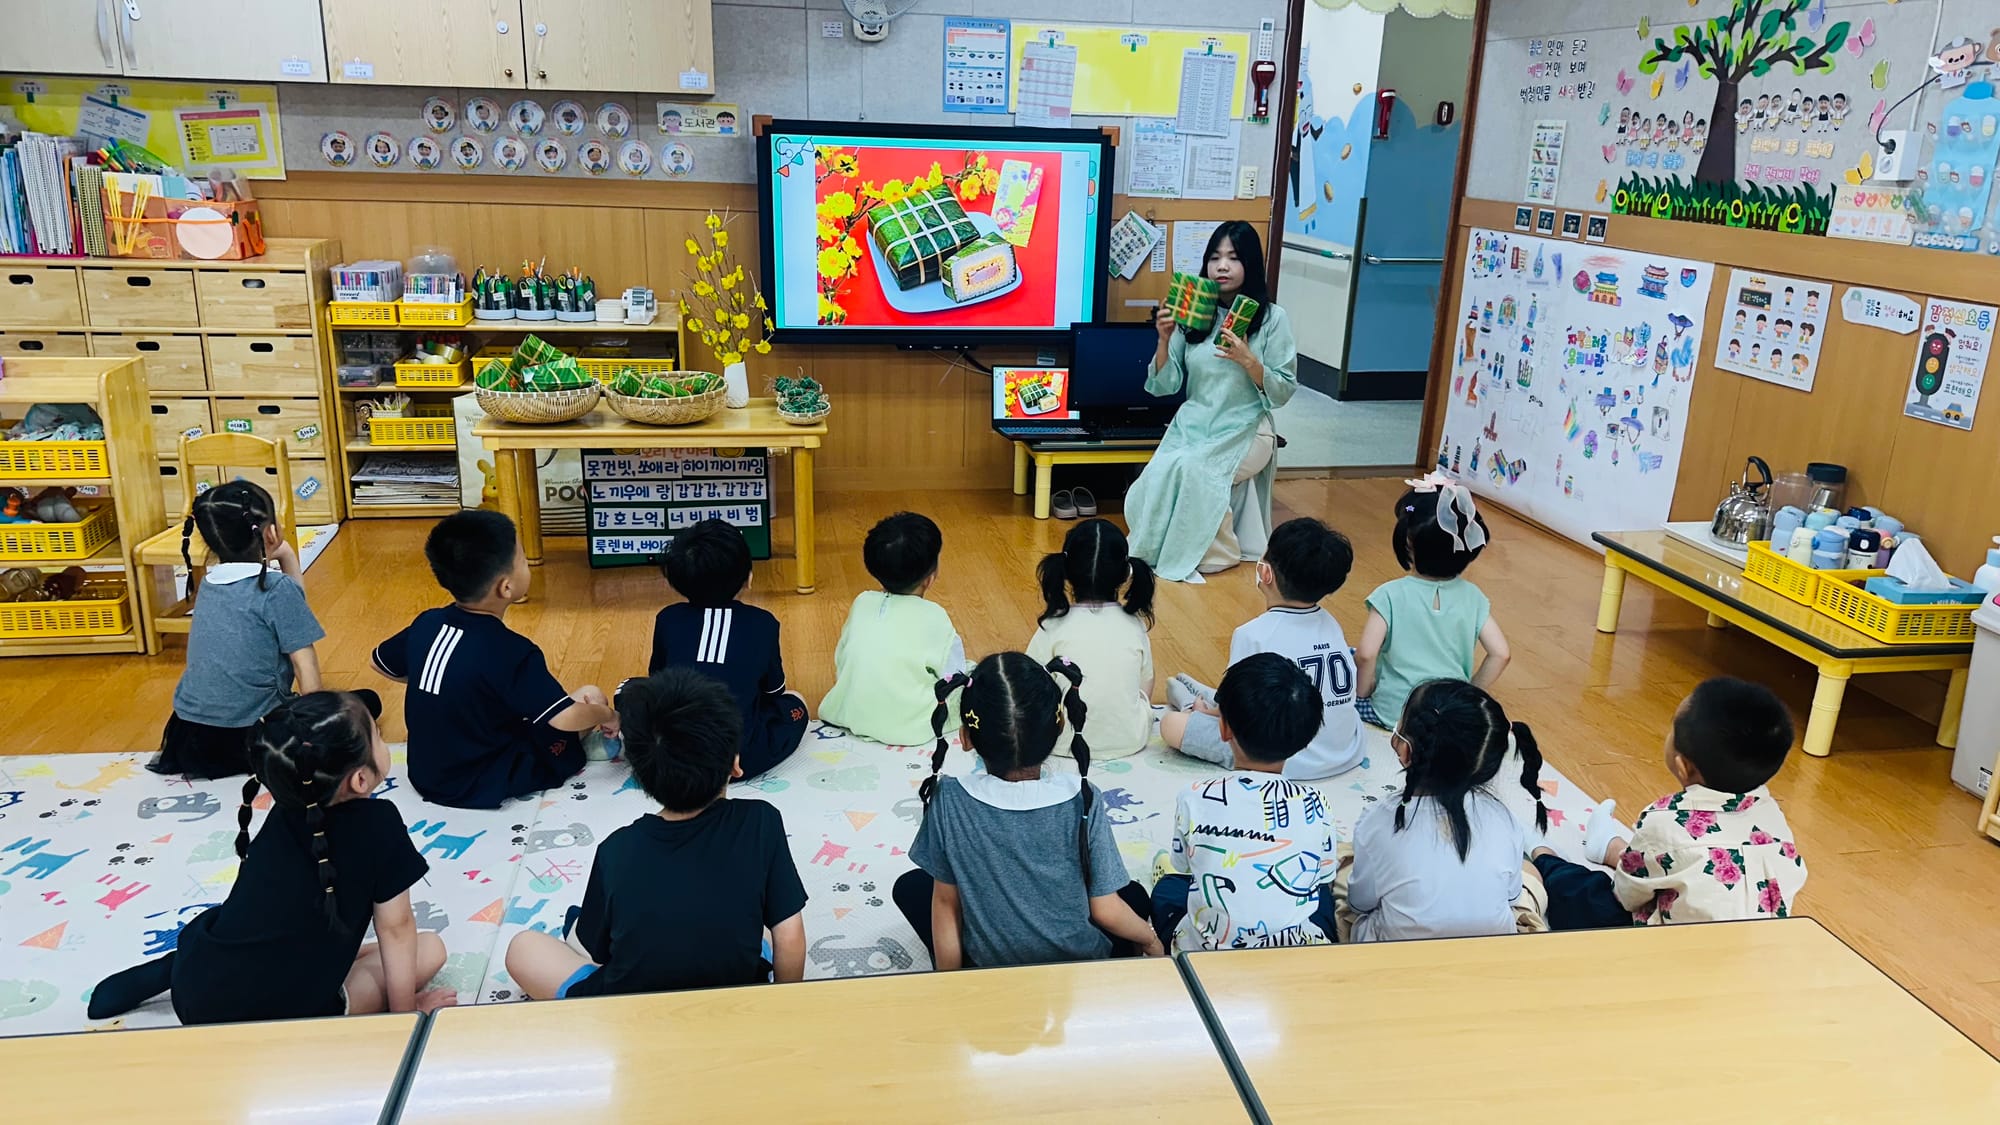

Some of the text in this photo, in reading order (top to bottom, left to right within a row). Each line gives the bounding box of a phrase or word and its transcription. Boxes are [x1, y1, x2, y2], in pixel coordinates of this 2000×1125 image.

[685, 118, 715, 128] 도서관
[1931, 304, 1990, 331] 감정신호등
[656, 484, 670, 500] 랑
[1313, 643, 1330, 651] PARIS
[1297, 651, 1353, 697] 70
